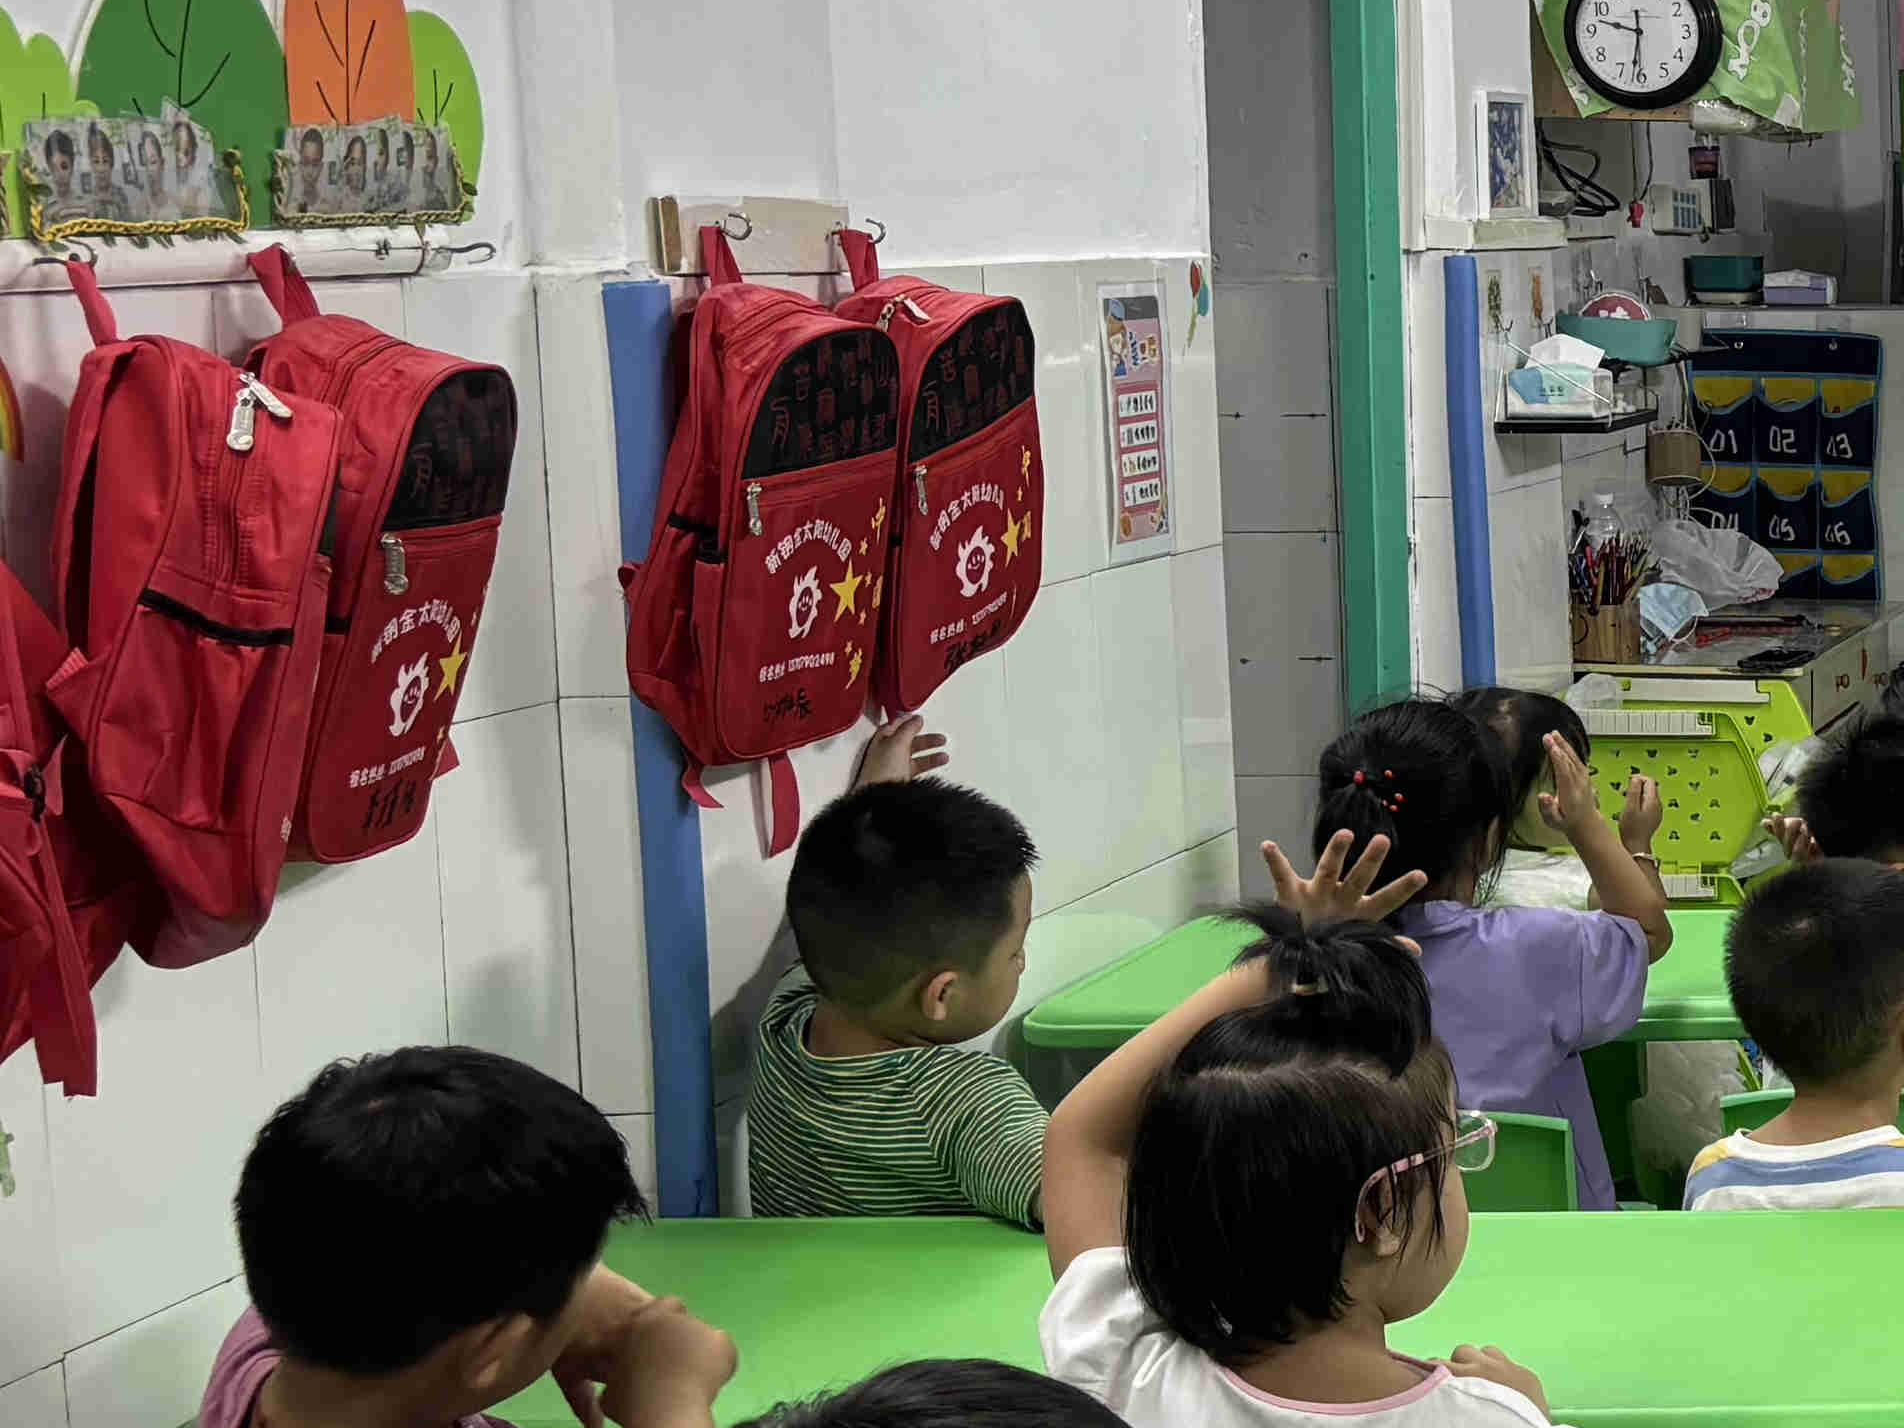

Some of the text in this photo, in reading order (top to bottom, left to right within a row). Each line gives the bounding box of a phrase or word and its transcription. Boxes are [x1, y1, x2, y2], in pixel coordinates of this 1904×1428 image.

[1594, 2, 1609, 16] 10
[1672, 2, 1681, 17] 2
[1586, 23, 1597, 38] 9
[1681, 24, 1691, 39] 3
[1596, 46, 1606, 62] 8
[1673, 48, 1683, 62] 4
[1616, 62, 1625, 78] 7
[1636, 68, 1647, 84] 6
[1659, 62, 1669, 78] 5
[1709, 429, 1738, 454] 01
[1769, 425, 1797, 454] 02
